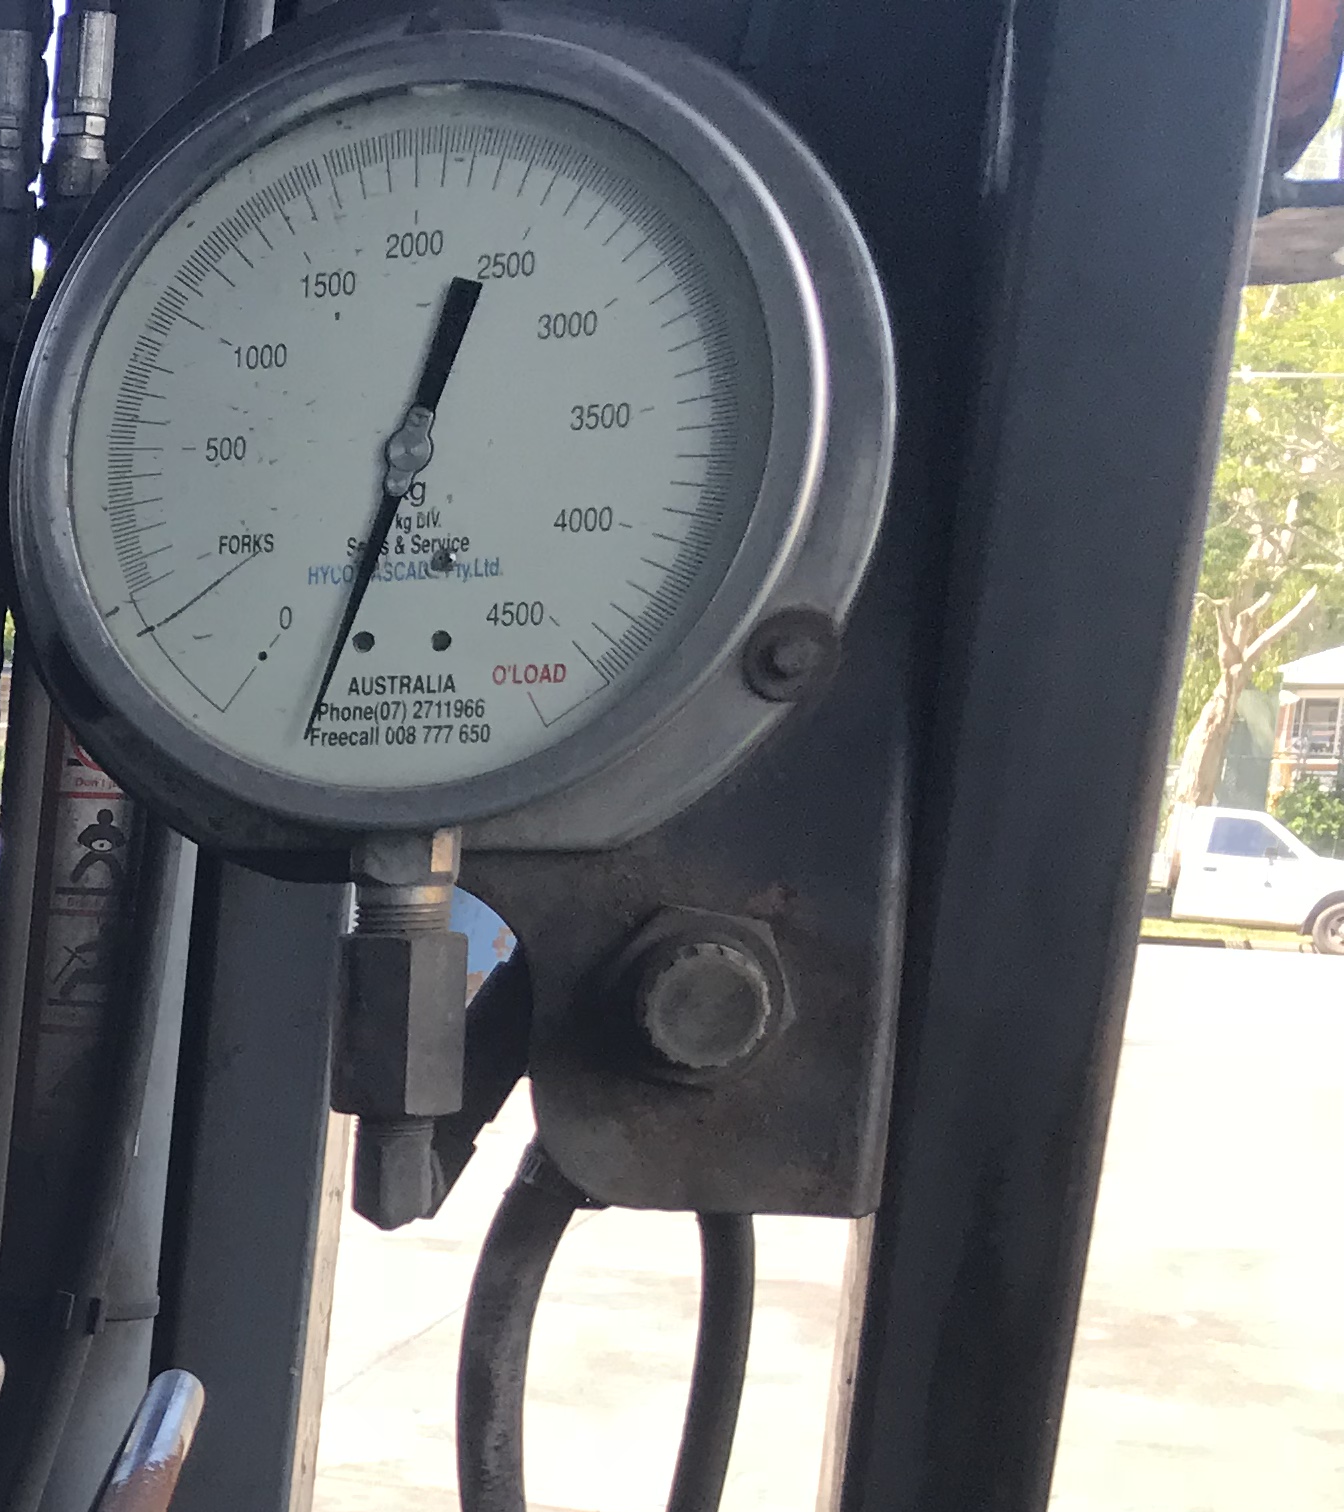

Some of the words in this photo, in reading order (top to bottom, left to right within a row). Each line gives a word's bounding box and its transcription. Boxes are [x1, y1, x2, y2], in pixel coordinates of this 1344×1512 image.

[385, 229, 444, 260] 2000
[476, 249, 536, 281] 2500
[300, 270, 357, 299] 1500
[536, 309, 598, 341] 3000
[233, 342, 288, 370] 1000
[569, 401, 630, 431] 3500
[204, 435, 247, 462] 500
[552, 504, 614, 534] 4000
[218, 533, 275, 555] FORKS
[394, 535, 406, 555] &
[410, 532, 470, 553] Service
[278, 605, 293, 631] 0
[485, 600, 545, 627] 4500
[347, 673, 457, 696] AUSTRALIA
[491, 663, 567, 686] O'LOAD
[317, 699, 408, 725] Phone(07)
[412, 697, 486, 720] 2711966
[309, 726, 380, 747] Freecall
[385, 725, 417, 746] 008
[422, 724, 454, 744] 777
[458, 723, 491, 744] 650
